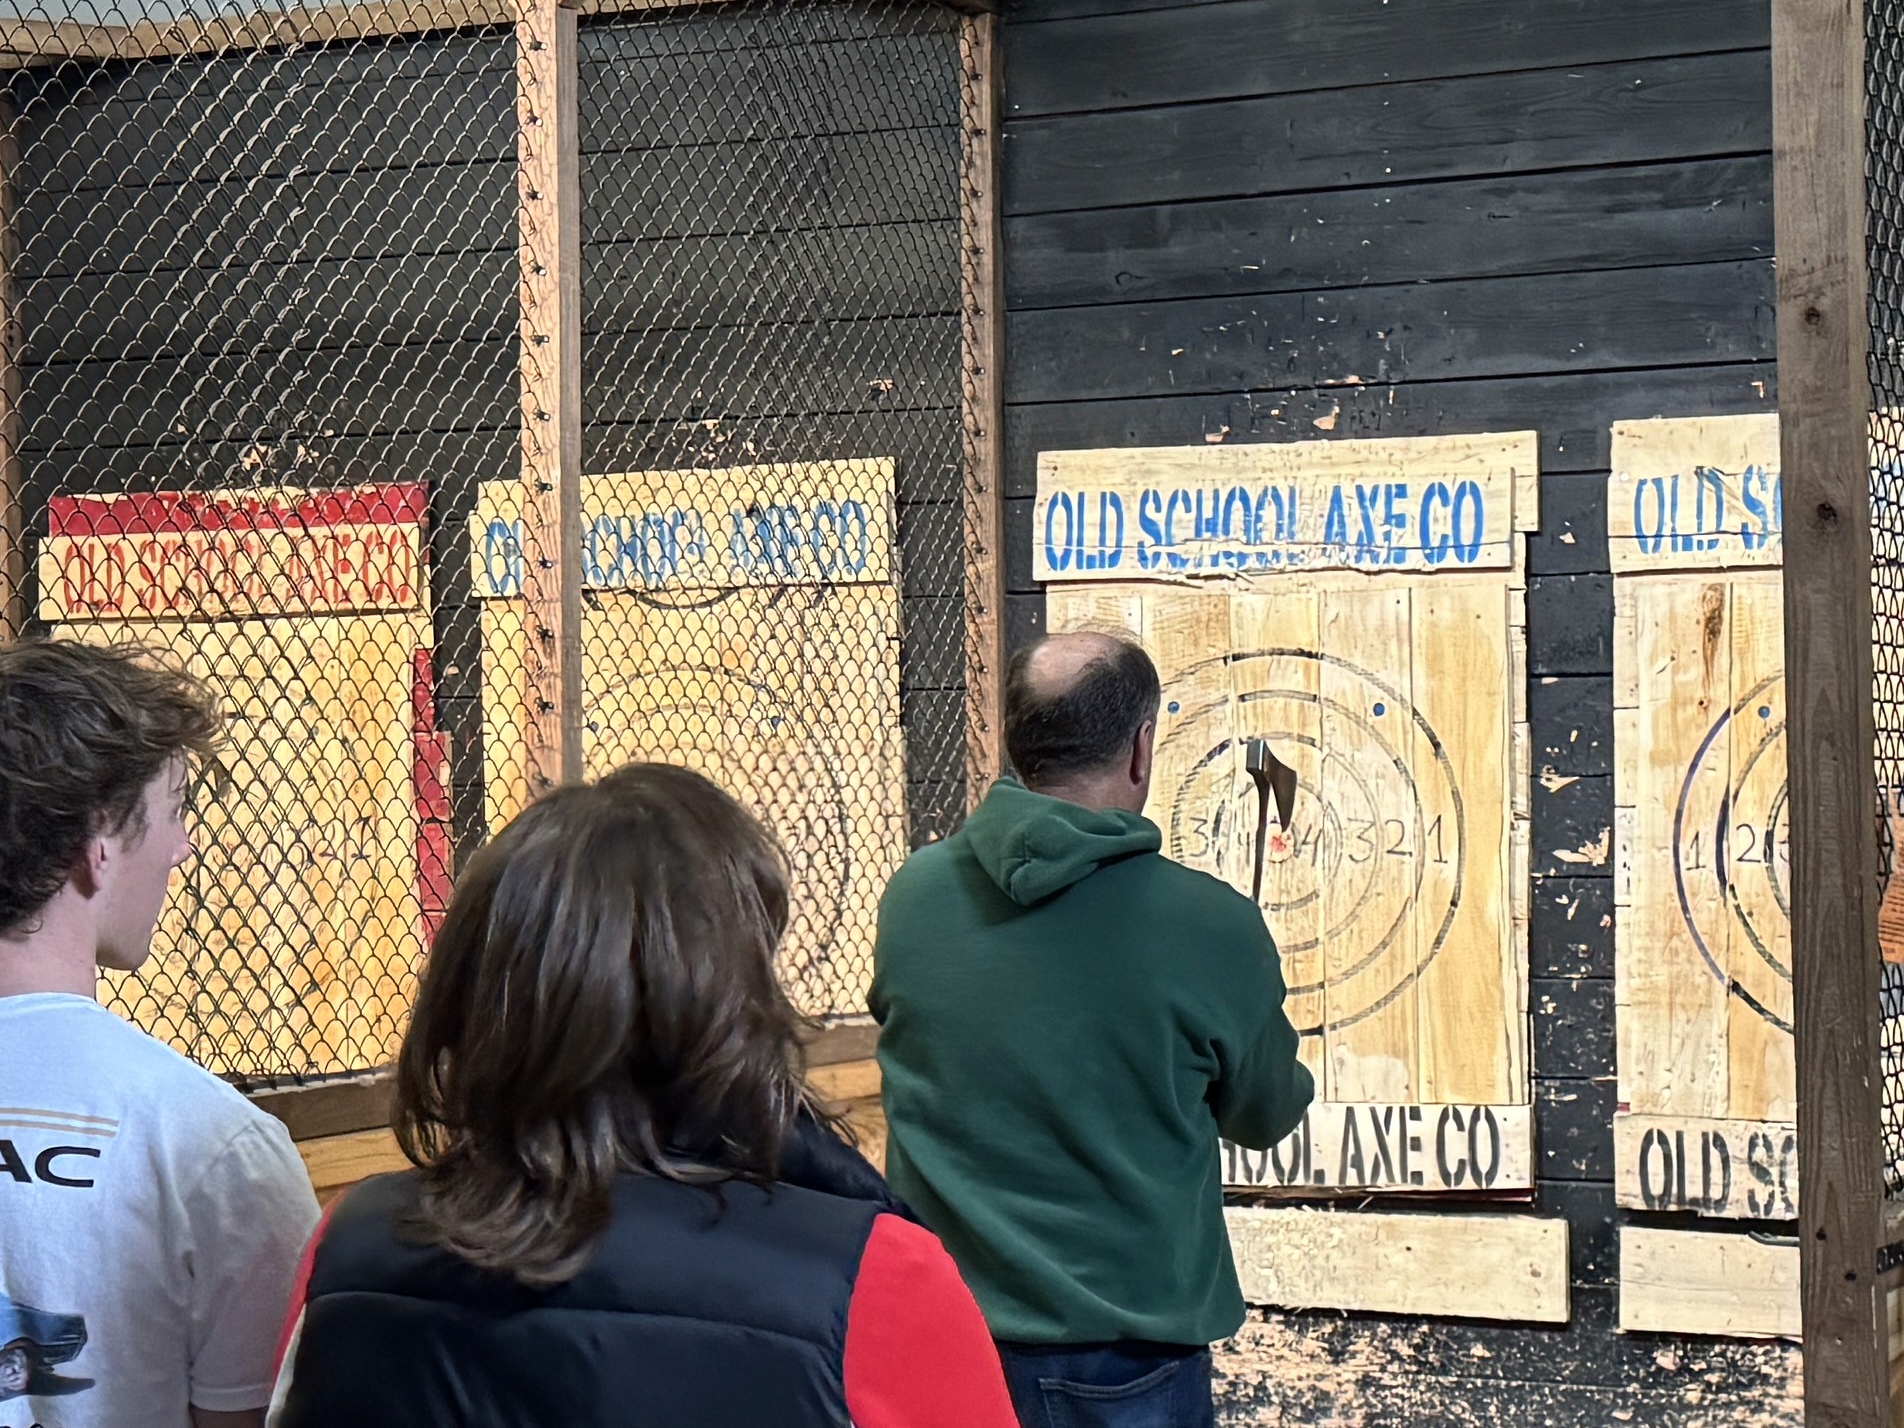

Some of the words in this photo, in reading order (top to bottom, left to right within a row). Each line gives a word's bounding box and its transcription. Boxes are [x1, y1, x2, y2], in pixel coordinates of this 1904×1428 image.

[1044, 490, 1124, 572] OLD
[1137, 484, 1299, 570] SCHOOL
[1324, 483, 1409, 566] AXE
[1418, 480, 1484, 565] CO
[1633, 466, 1724, 555] OLD
[1740, 464, 1782, 551] S
[1190, 817, 1209, 858] 3
[1347, 817, 1375, 864] 3
[1385, 818, 1413, 858] 2
[1427, 813, 1448, 865] 1
[1685, 830, 1707, 872] 1
[1735, 822, 1762, 863] 2
[1339, 1105, 1424, 1186] AXE
[1436, 1104, 1499, 1189] CO
[1639, 1128, 1731, 1214] OLD
